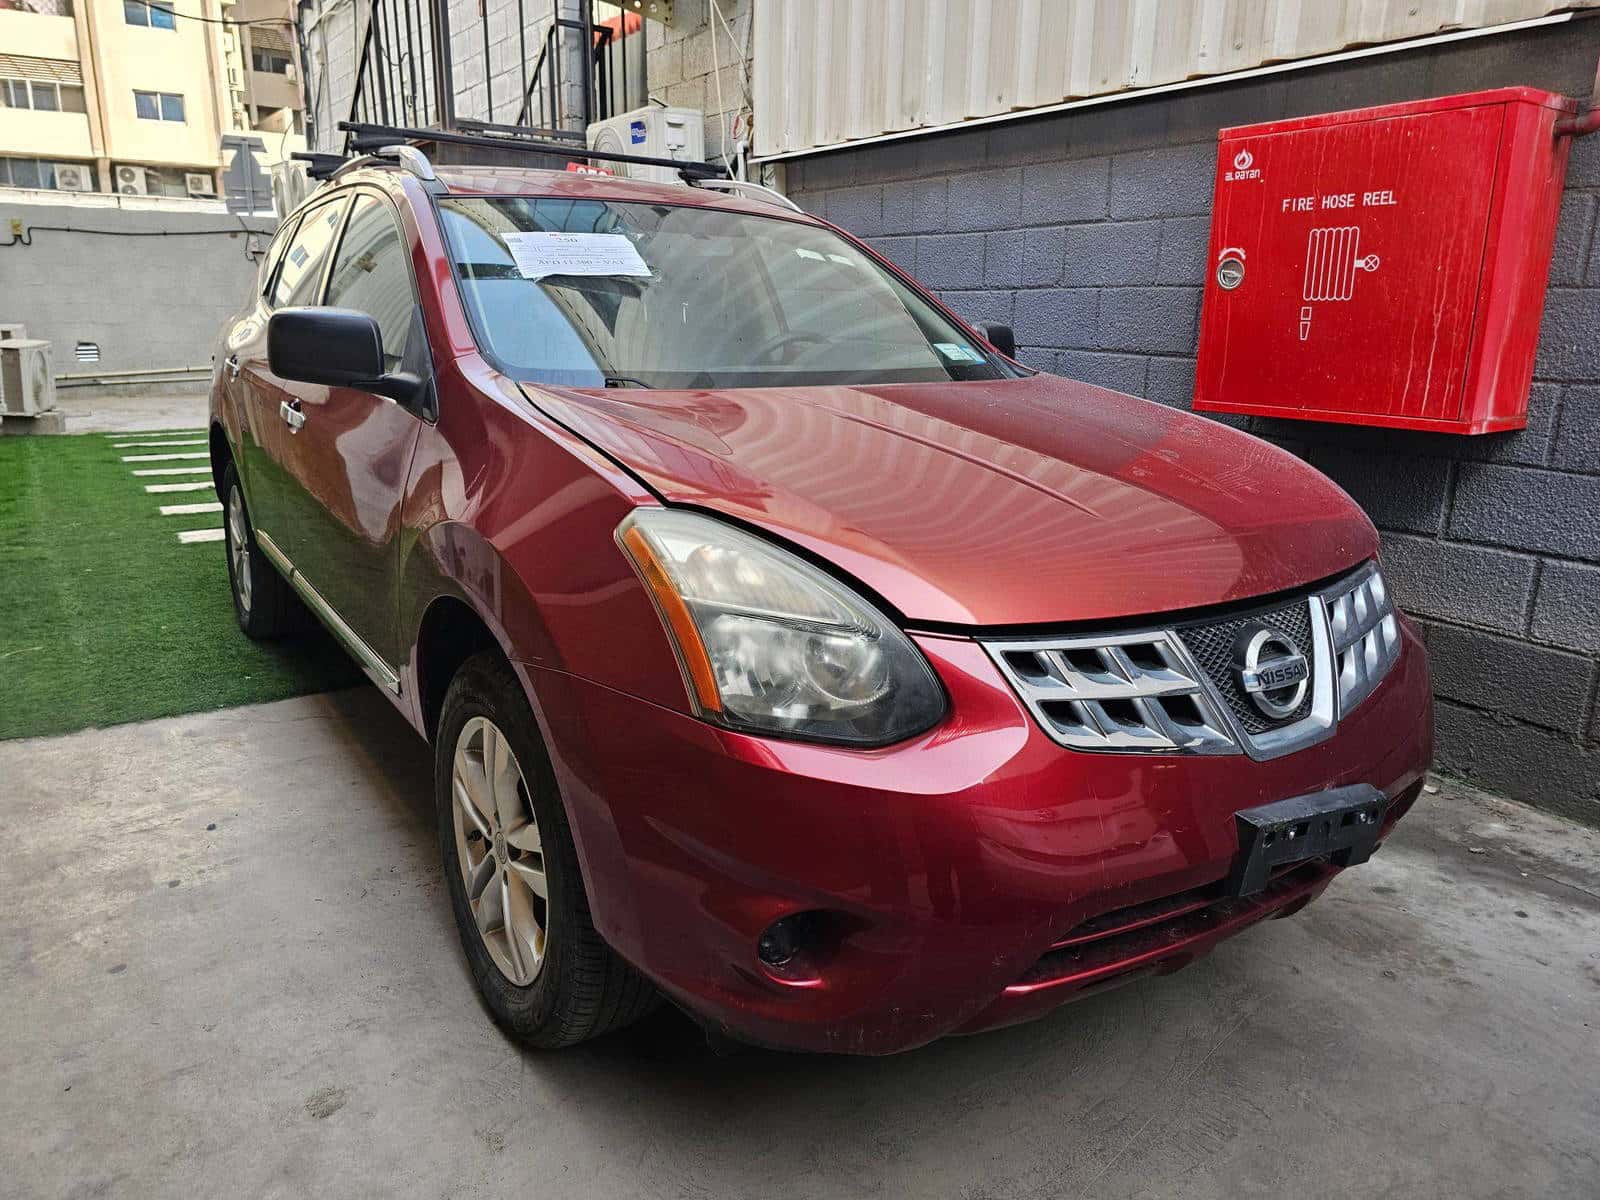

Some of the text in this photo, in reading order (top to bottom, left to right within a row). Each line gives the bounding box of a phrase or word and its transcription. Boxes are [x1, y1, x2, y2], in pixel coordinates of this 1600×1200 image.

[1282, 190, 1397, 213] FIRE HOSE REEL
[1257, 664, 1306, 687] NISSAN
